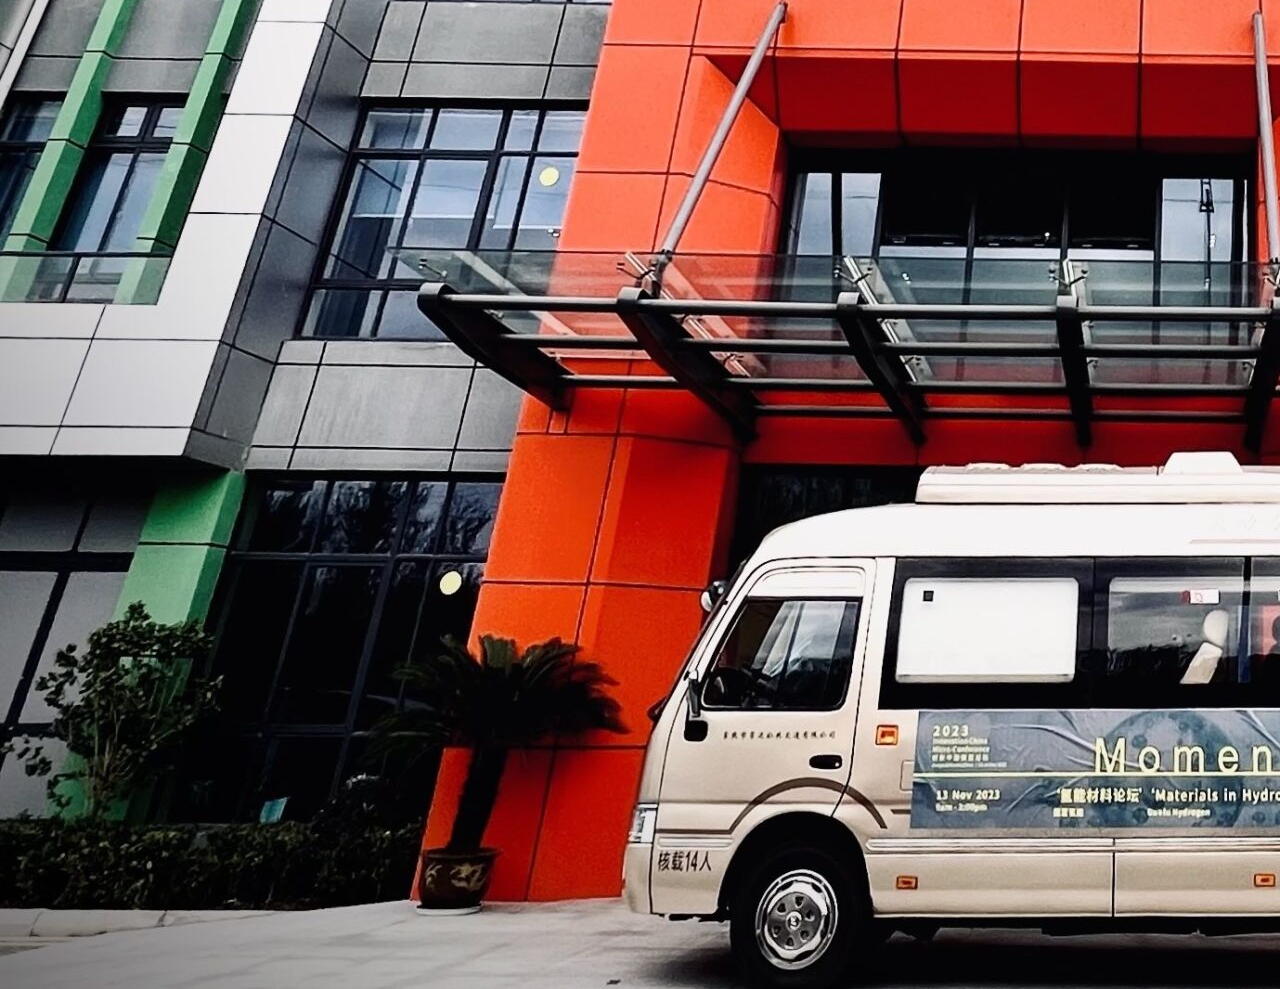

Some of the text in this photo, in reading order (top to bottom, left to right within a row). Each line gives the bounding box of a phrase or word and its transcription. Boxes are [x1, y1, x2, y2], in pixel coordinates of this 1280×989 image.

[932, 724, 970, 737] 2023
[936, 789, 1001, 801] 13 Nov 2023
[1223, 788, 1237, 802] in
[658, 850, 712, 872] 核载14人
